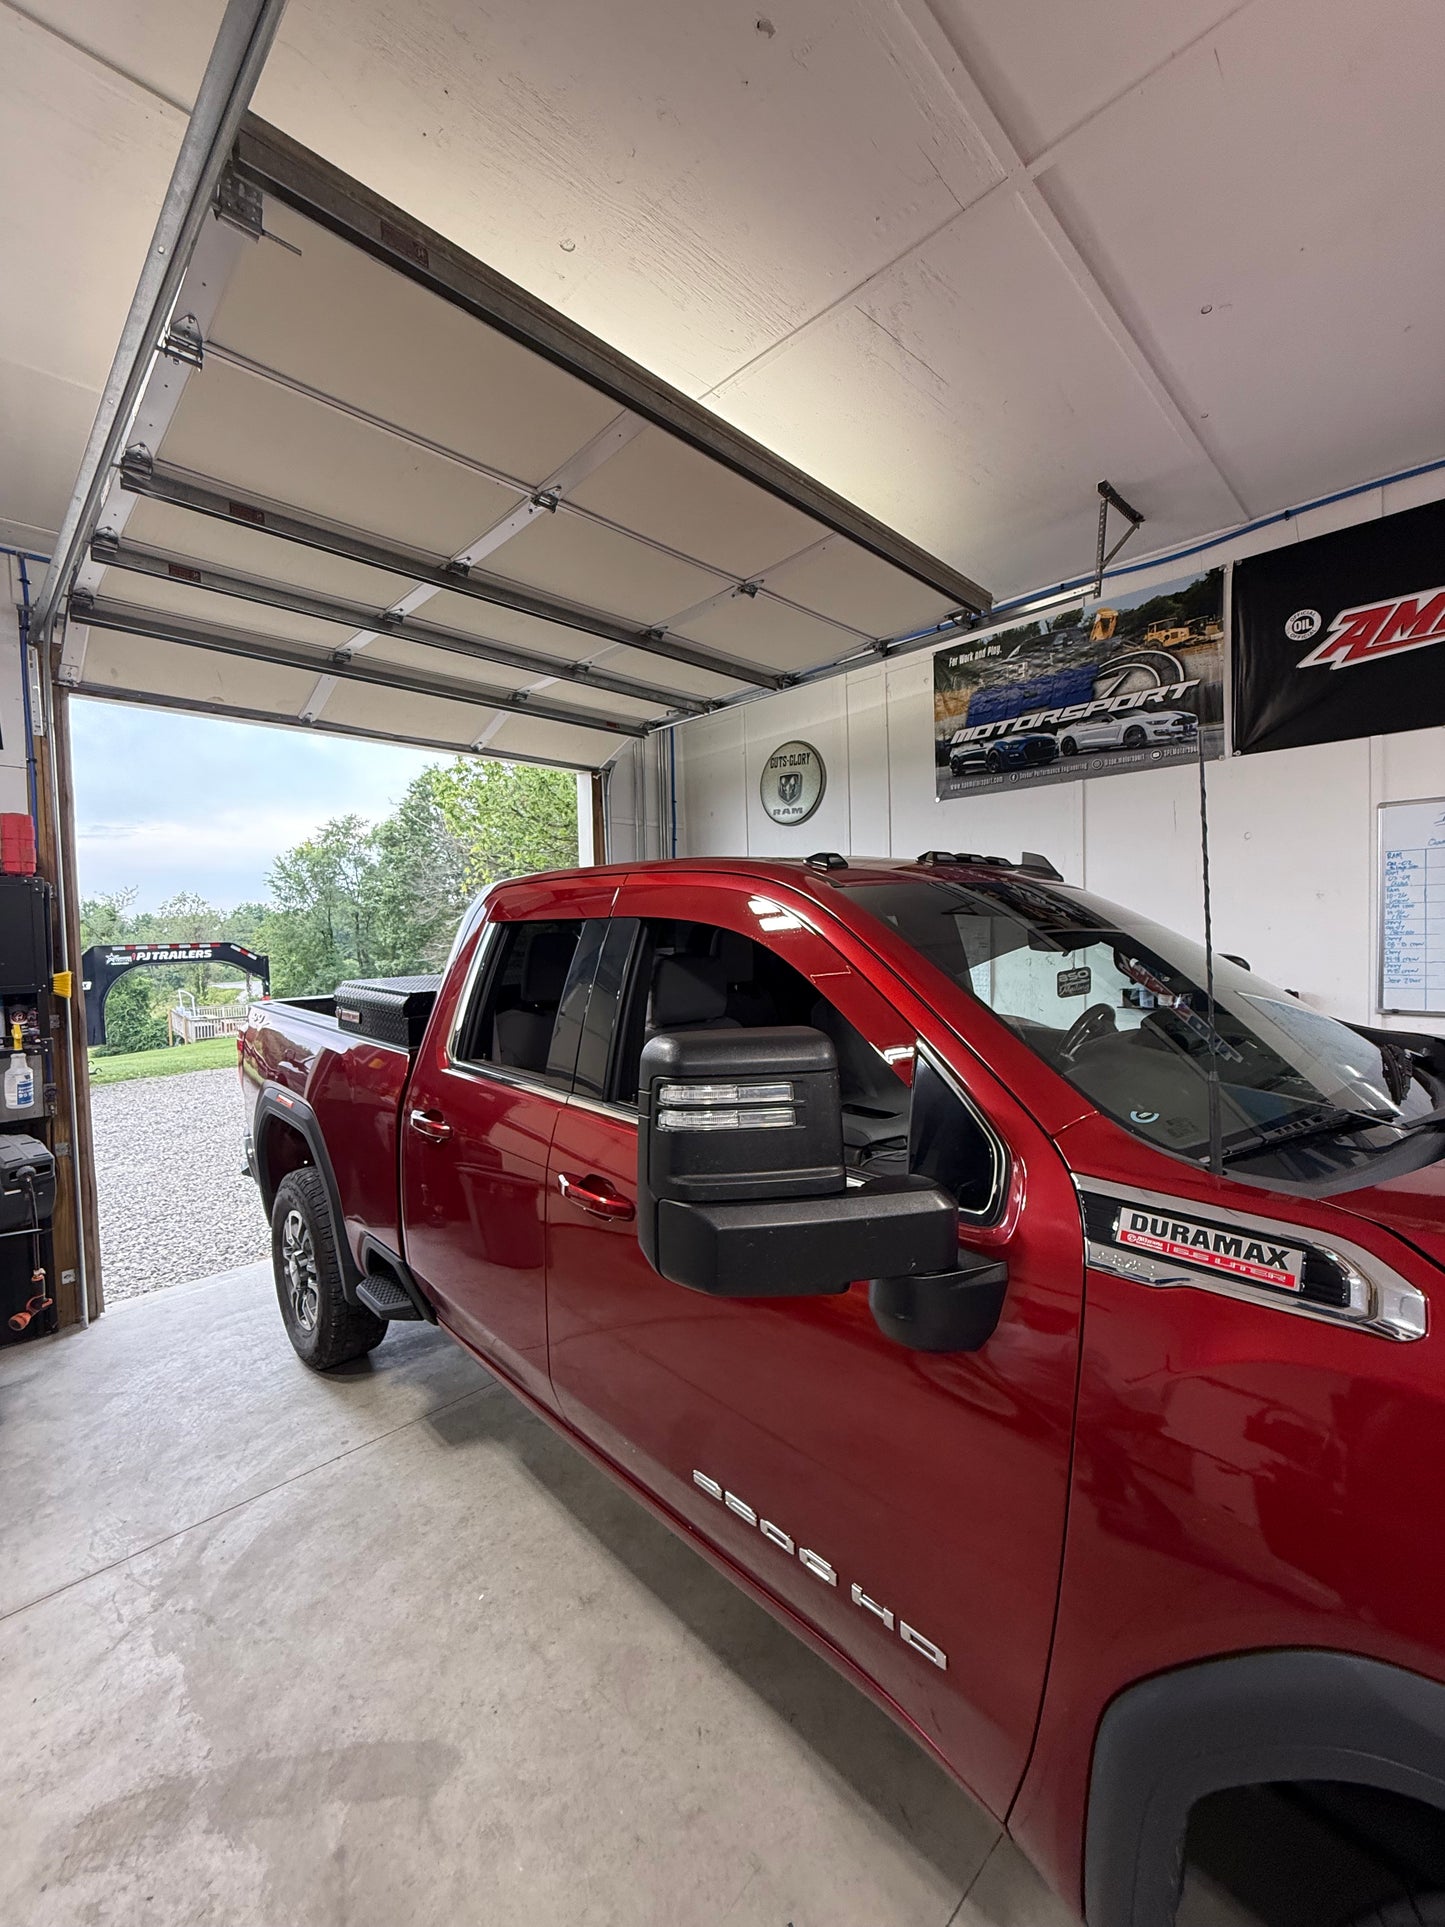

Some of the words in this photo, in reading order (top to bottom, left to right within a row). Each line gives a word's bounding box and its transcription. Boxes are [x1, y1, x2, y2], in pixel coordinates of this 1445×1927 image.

[1290, 610, 1316, 622] OFFICIAL
[1293, 618, 1313, 632] OIL
[1297, 587, 1445, 669] AM
[1289, 629, 1316, 640] OFFICIAL
[949, 657, 958, 668] For
[959, 653, 973, 665] Work
[974, 647, 986, 660] and
[950, 679, 1200, 745] MOTORSPORT
[772, 807, 803, 816] RAM
[151, 949, 213, 960] TRAILERS
[1129, 1211, 1290, 1271] DURAMAX
[851, 1582, 948, 1671] HD
